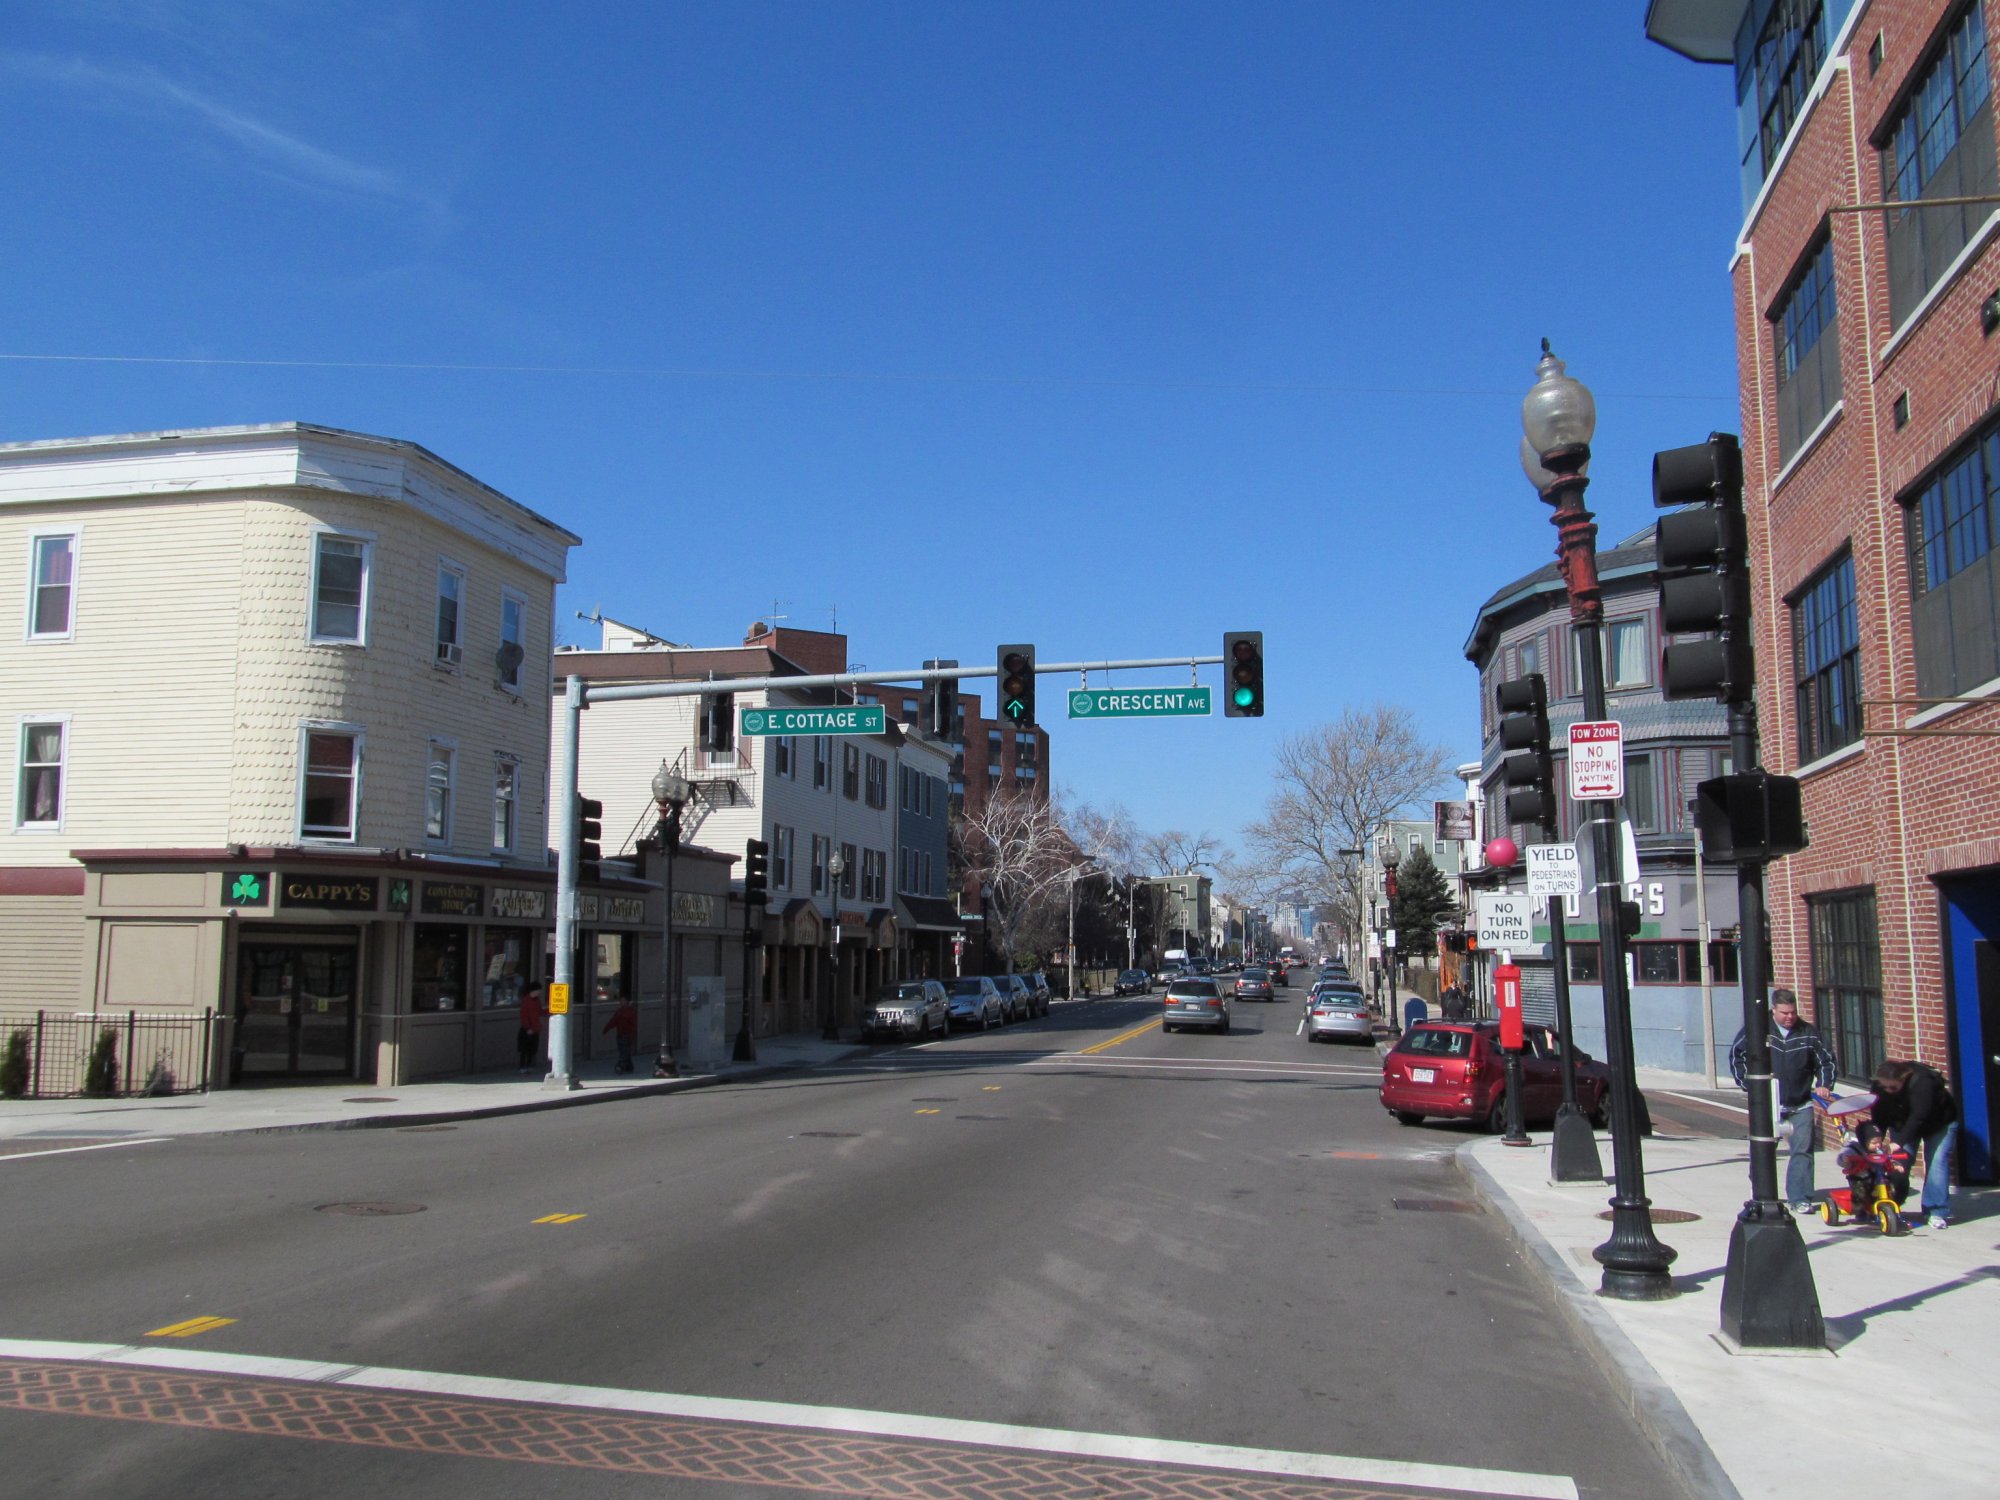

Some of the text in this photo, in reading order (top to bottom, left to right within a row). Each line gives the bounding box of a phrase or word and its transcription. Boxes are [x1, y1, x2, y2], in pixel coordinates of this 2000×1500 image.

[1097, 694, 1206, 711] CRESCENT AVE
[785, 712, 857, 729] COTTAGE
[865, 716, 877, 727] ST
[1571, 726, 1619, 739] TOW ZONE
[1587, 745, 1603, 758] NO
[1574, 759, 1617, 774] STOPPING
[1578, 774, 1615, 783] ANYTIME
[1532, 848, 1575, 861] YIELD
[1531, 869, 1577, 880] PEDESTRIANS
[1534, 880, 1576, 891] ON TURNS
[288, 883, 371, 902] CAPPY'S
[1494, 903, 1514, 914] NO
[1488, 916, 1522, 927] TURN
[1481, 930, 1529, 941] ON RED
